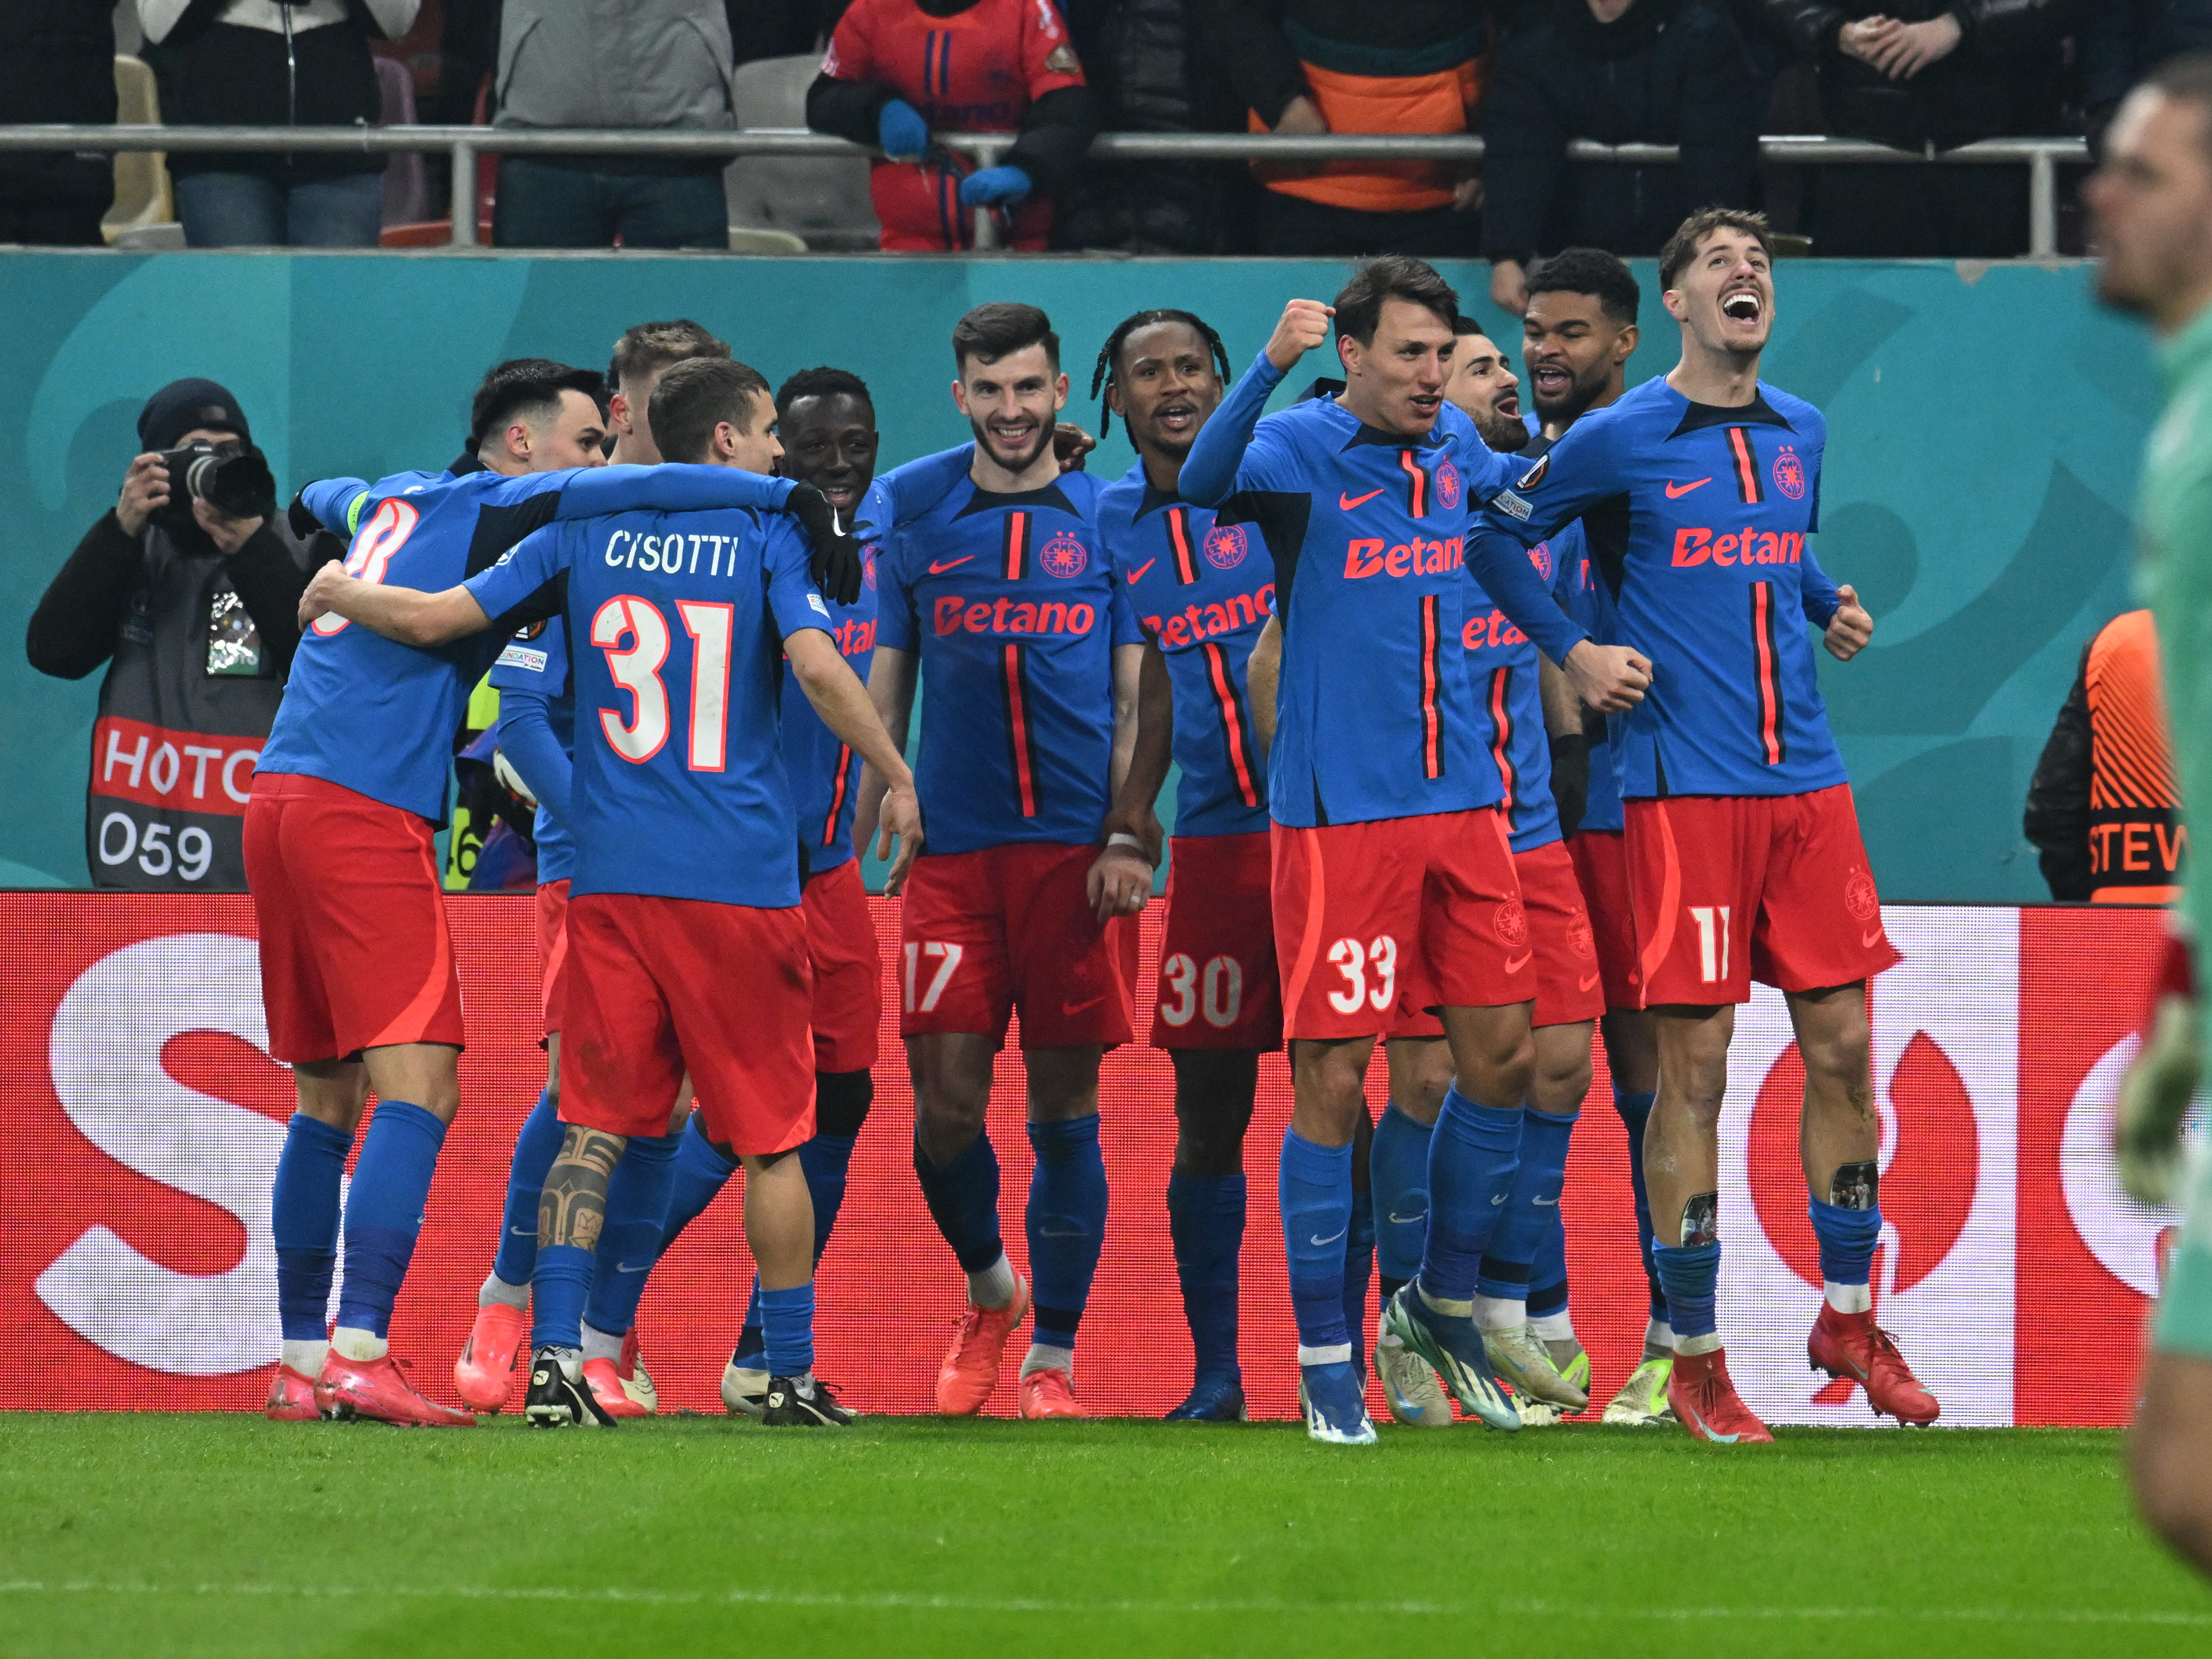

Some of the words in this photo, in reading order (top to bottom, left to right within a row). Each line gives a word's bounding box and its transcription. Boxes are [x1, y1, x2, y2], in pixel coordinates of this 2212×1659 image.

[605, 529, 738, 577] CISOTTI
[934, 596, 1095, 636] Betano
[1462, 609, 1529, 650] eta
[590, 594, 735, 773] 31
[99, 811, 213, 881] 059
[904, 942, 963, 1013] 17
[1326, 934, 1397, 1016] 33
[1688, 905, 1730, 984] 11
[1160, 952, 1242, 1029] 30
